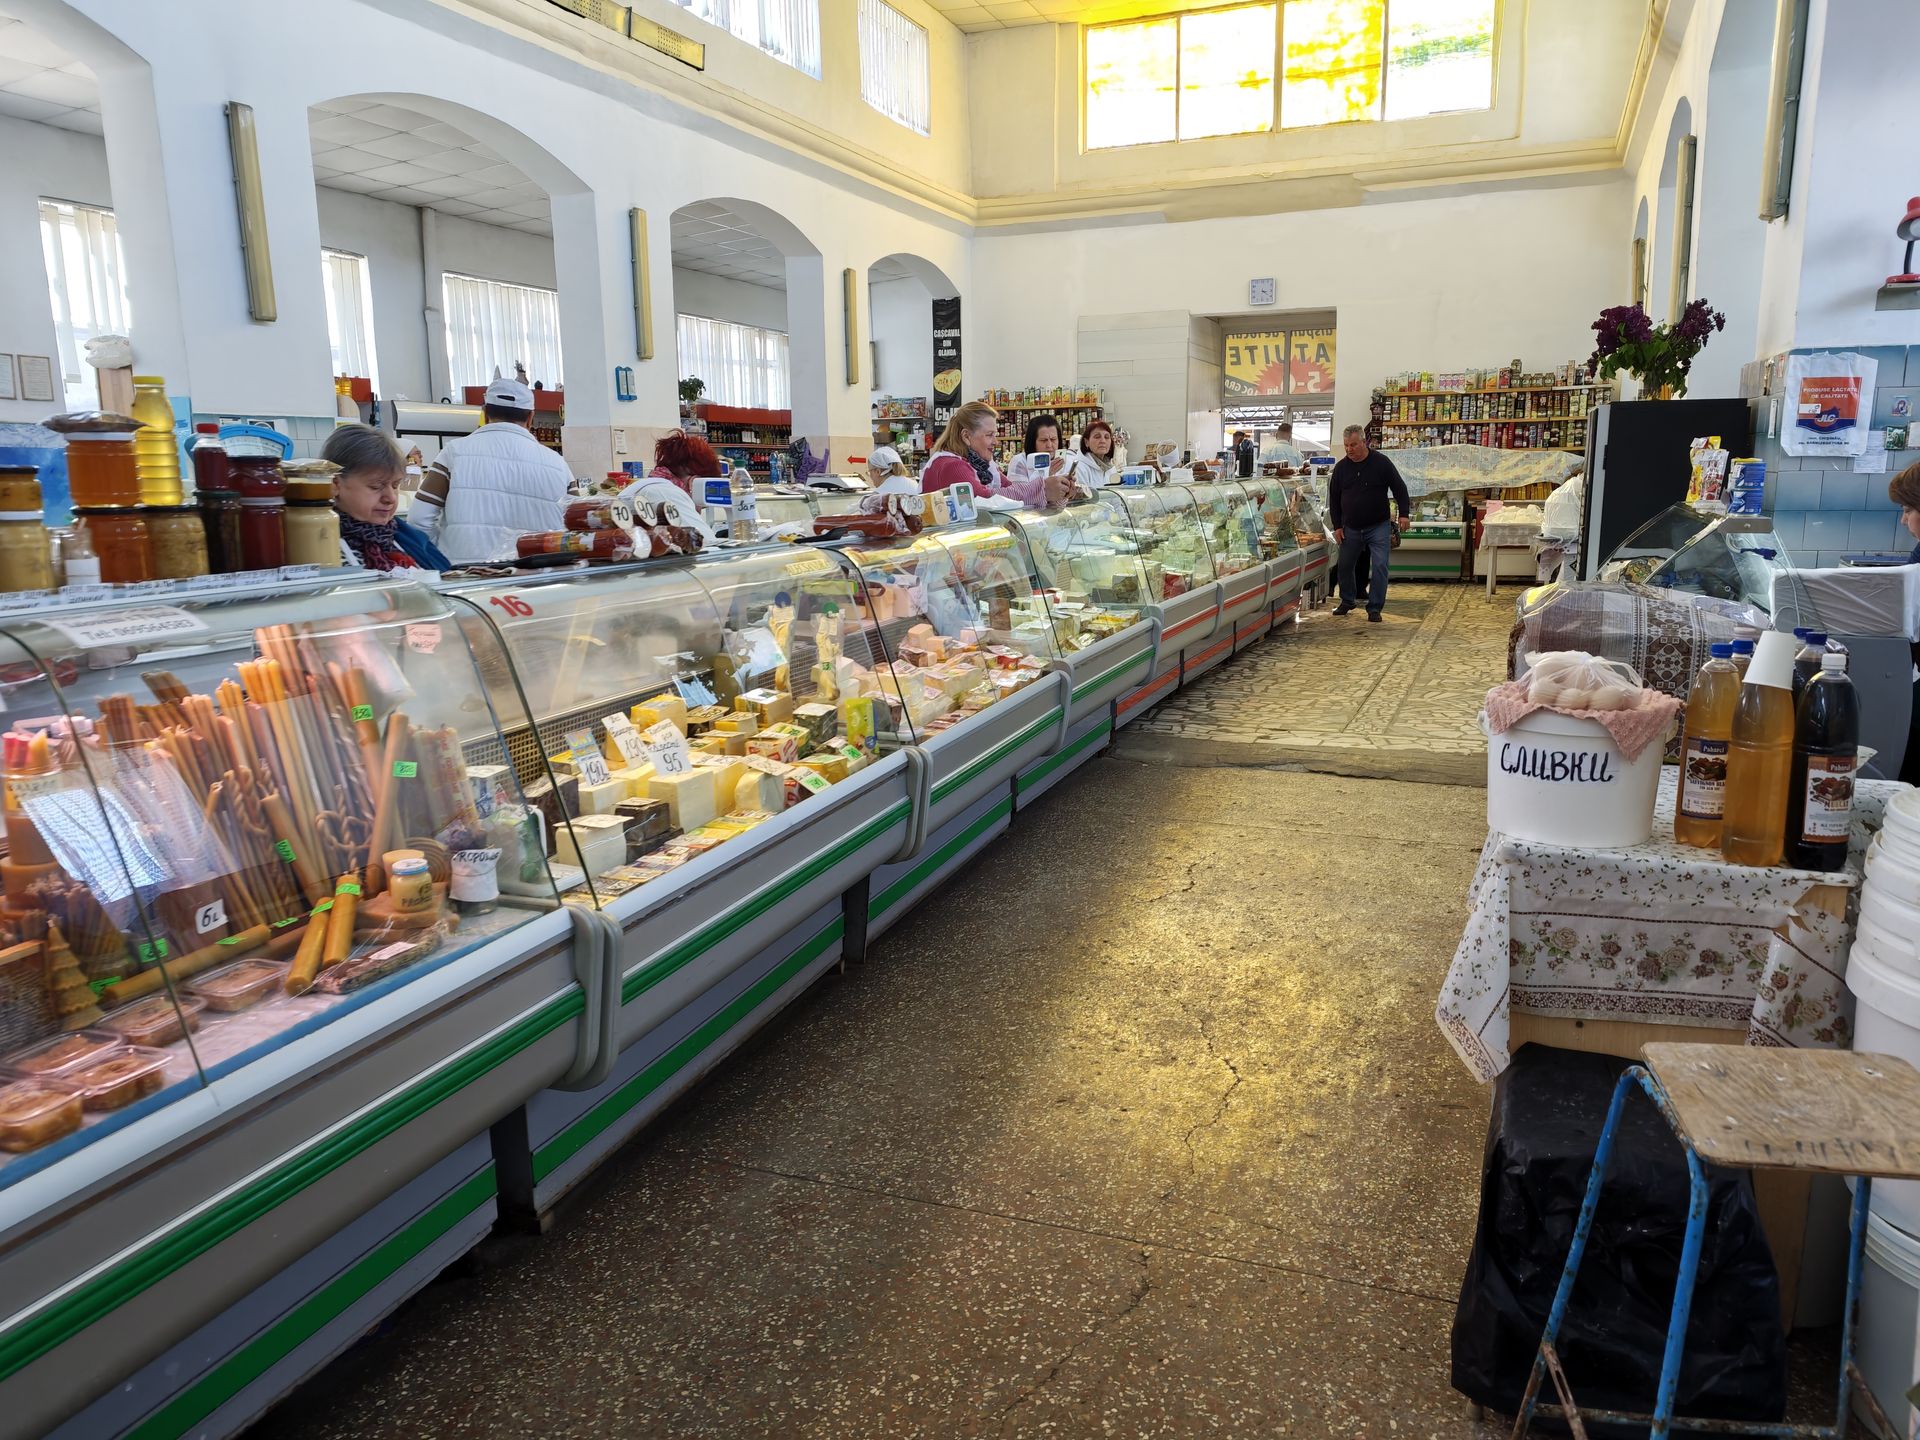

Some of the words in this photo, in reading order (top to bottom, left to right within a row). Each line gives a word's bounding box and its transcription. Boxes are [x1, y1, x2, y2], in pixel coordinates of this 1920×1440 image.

[1818, 414, 1836, 422] JLC
[613, 506, 630, 522] 70
[636, 500, 656, 520] 90
[489, 594, 534, 617] 16
[662, 752, 683, 773] 95
[1500, 742, 1615, 783] СЛИВКИ
